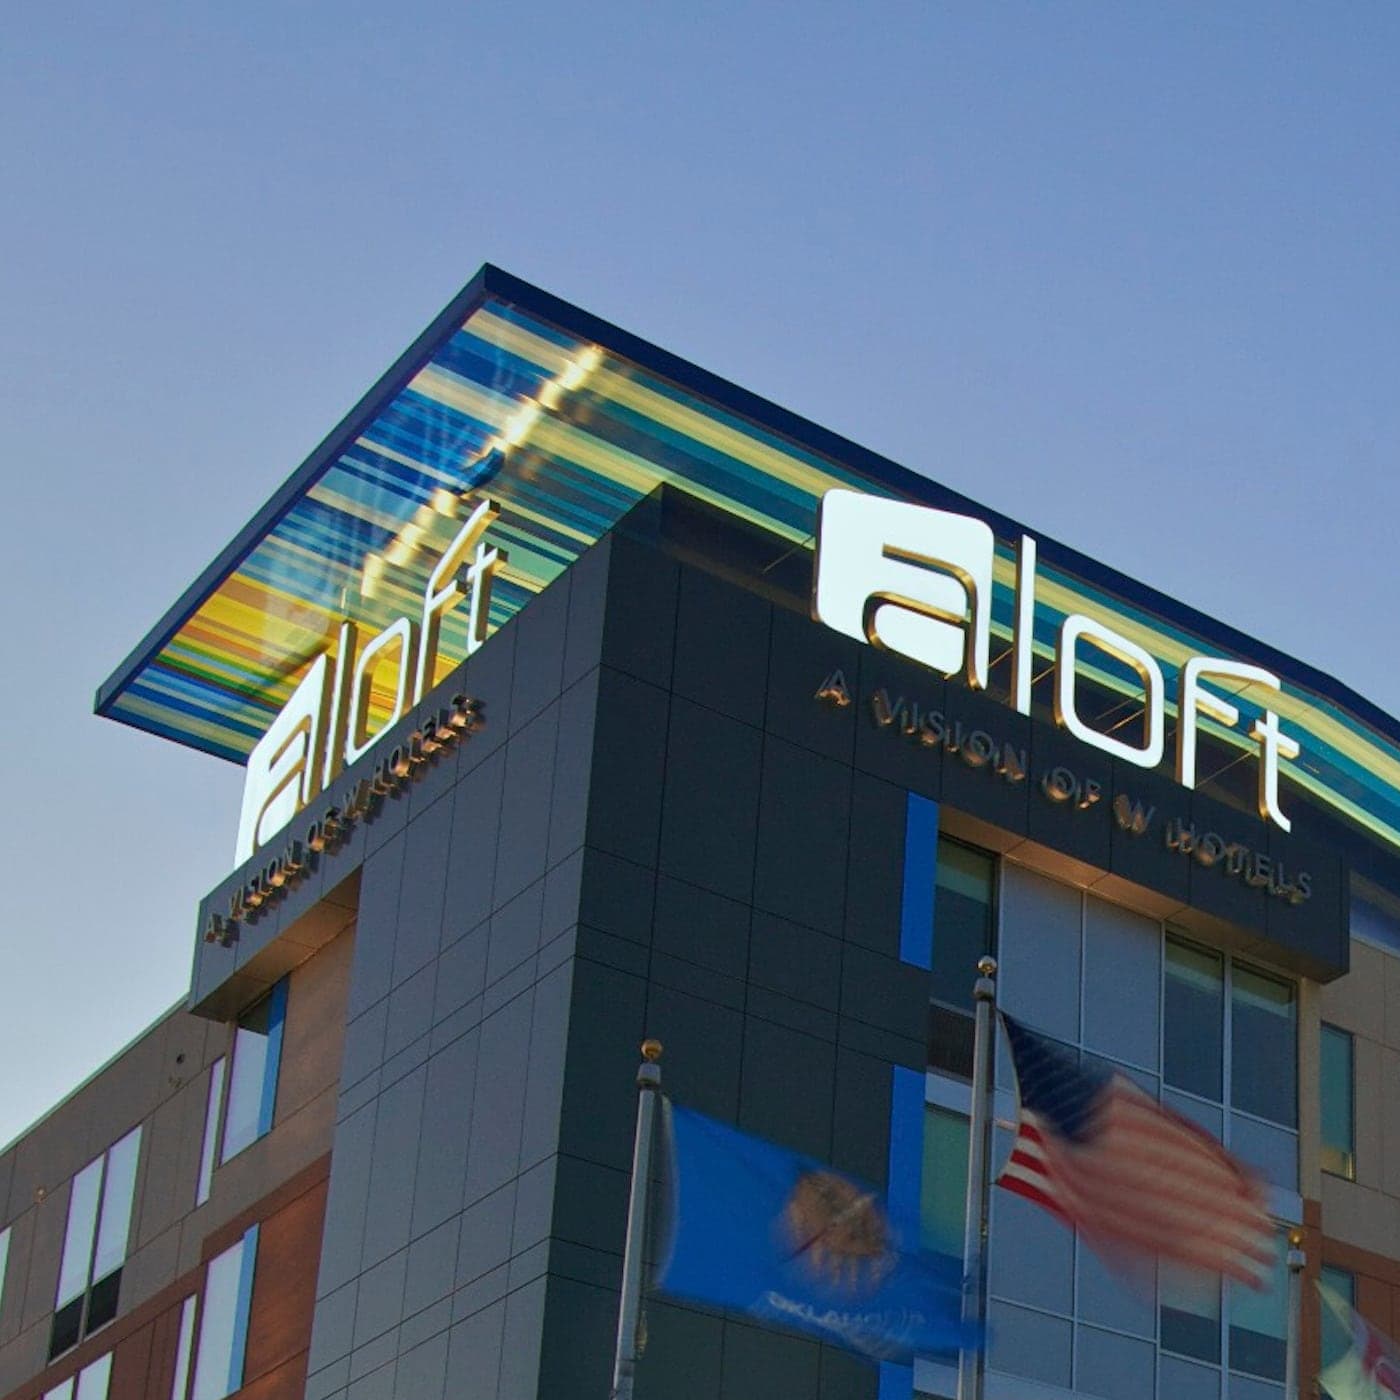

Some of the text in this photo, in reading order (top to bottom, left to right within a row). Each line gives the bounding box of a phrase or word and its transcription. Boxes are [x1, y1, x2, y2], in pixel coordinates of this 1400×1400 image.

[815, 669, 1312, 903] A VISION OF W HOTELS
